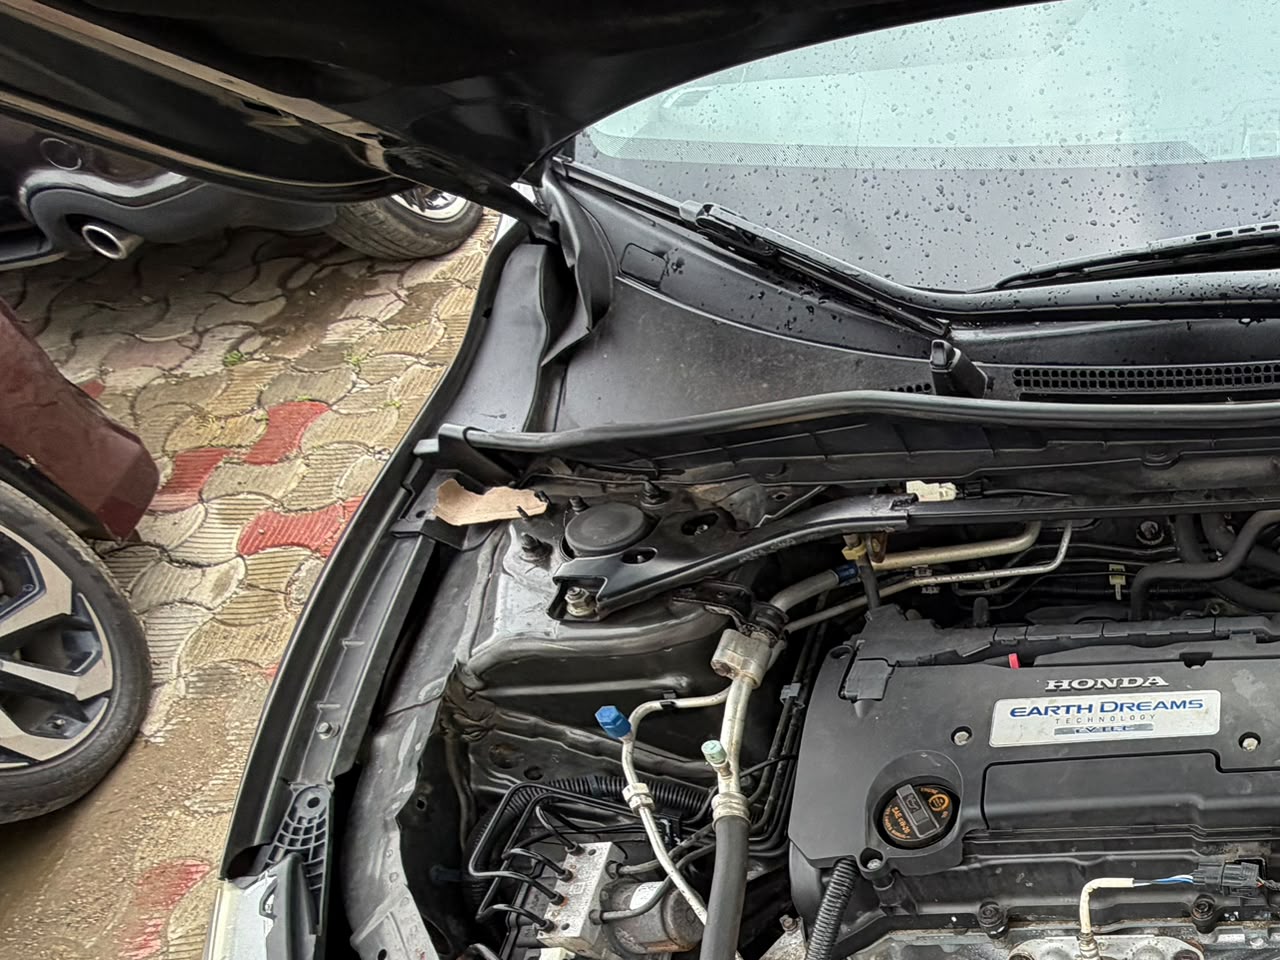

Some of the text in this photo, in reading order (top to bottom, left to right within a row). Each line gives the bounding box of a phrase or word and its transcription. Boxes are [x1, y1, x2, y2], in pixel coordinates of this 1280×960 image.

[1045, 676, 1169, 691] HONDA
[1009, 699, 1204, 718] EARTH DREAMS
[1055, 714, 1157, 725] TECHNOLOGY
